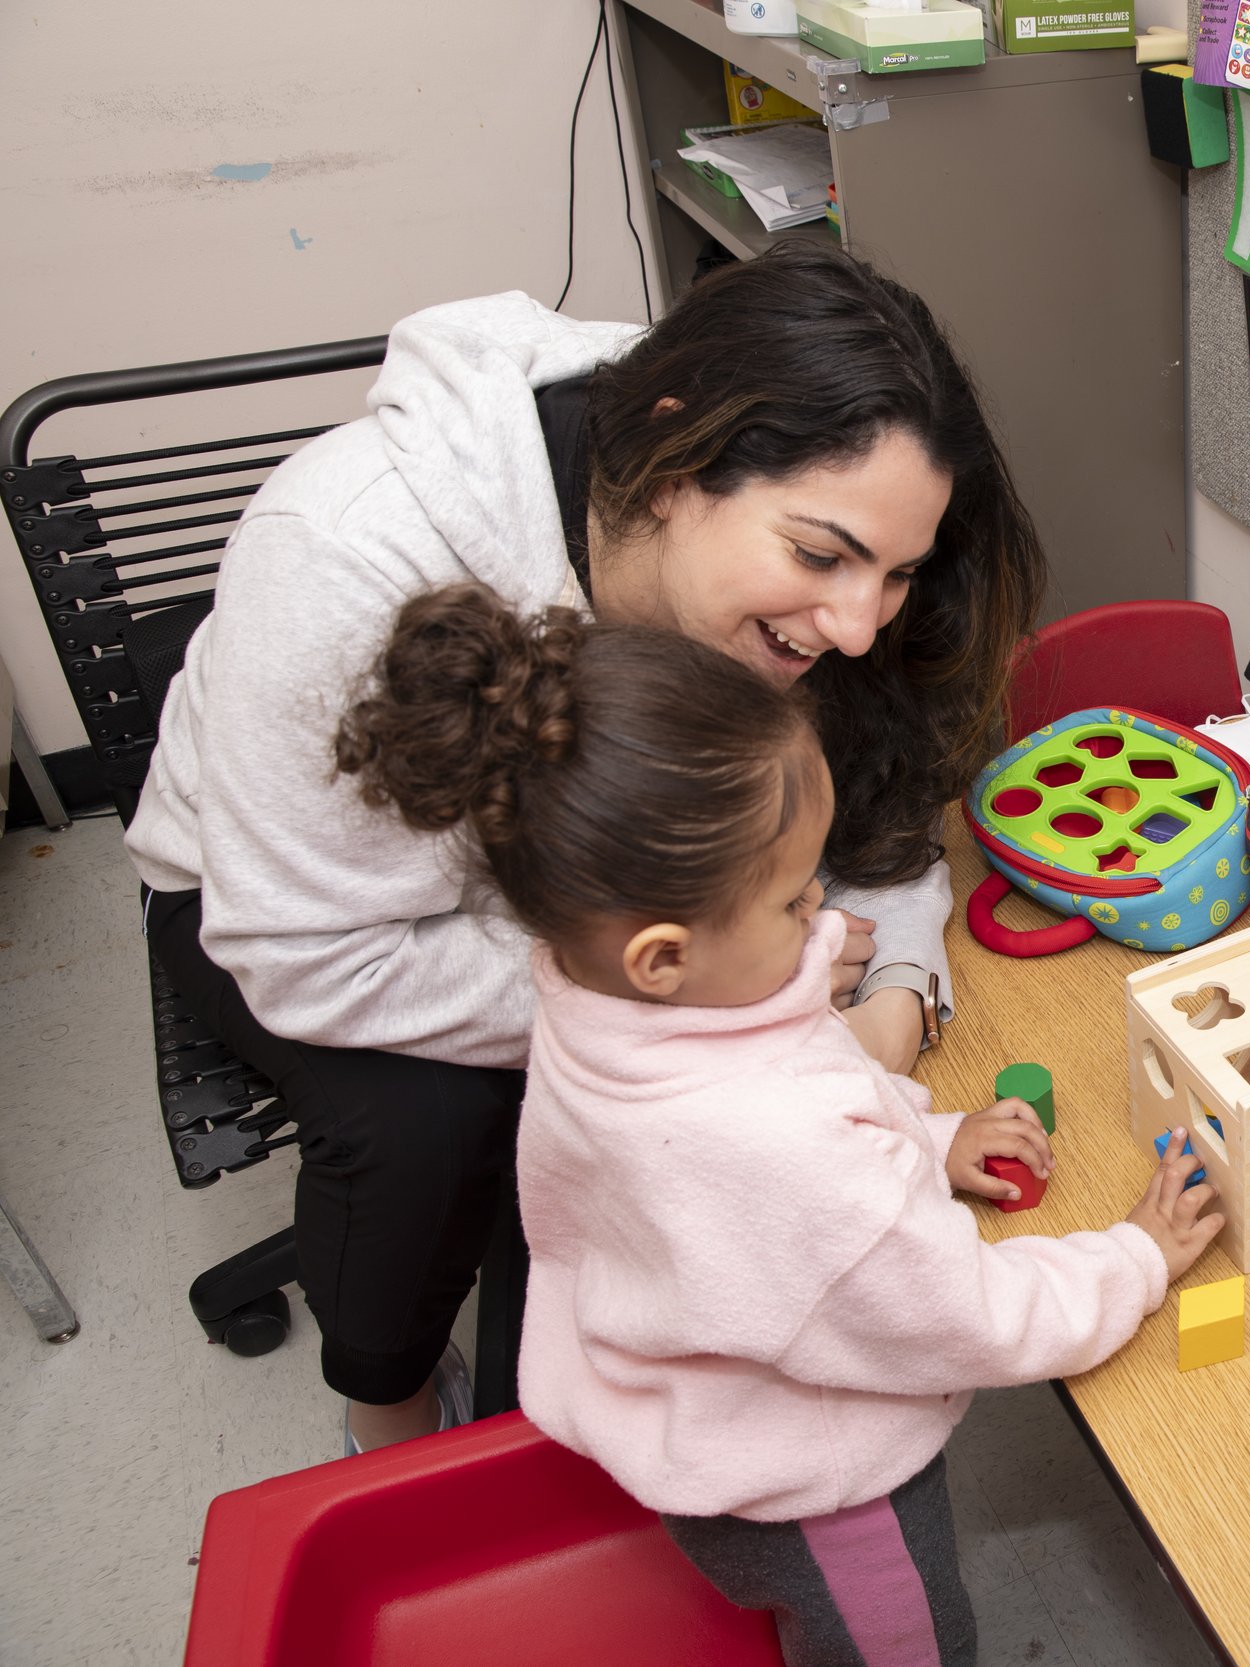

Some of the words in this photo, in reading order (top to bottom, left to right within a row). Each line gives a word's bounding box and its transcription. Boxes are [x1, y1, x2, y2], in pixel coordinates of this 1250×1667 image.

[1037, 16, 1058, 26] LATEX
[1059, 14, 1087, 24] POWDER
[1087, 12, 1104, 23] FREE
[1104, 11, 1130, 21] GLOVES
[1020, 19, 1031, 32] M
[883, 54, 908, 65] Marcal
[909, 55, 919, 63] Pro
